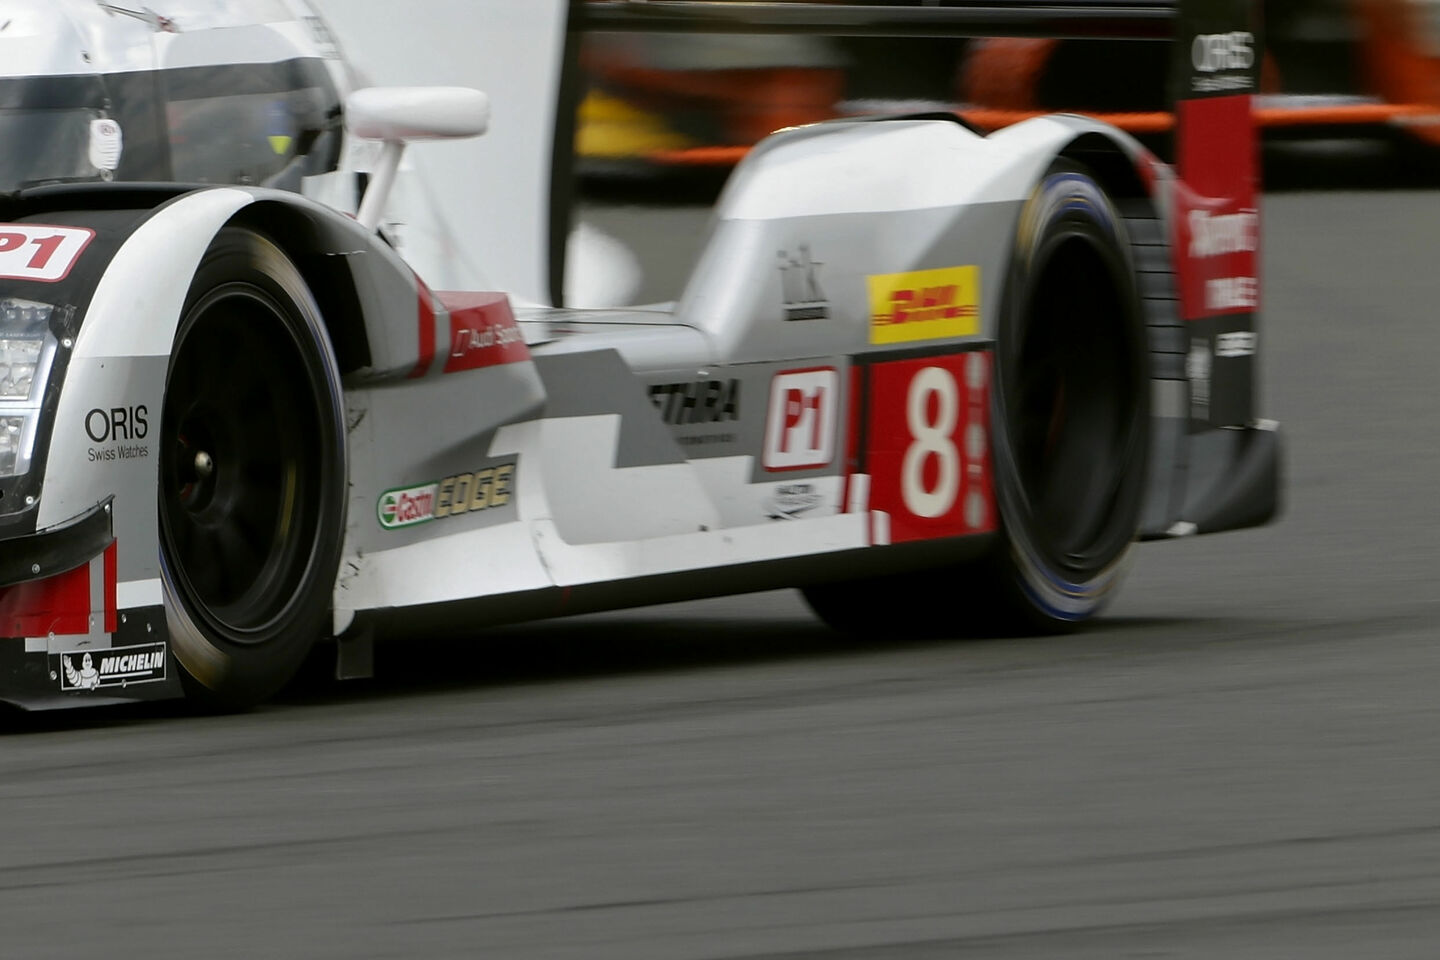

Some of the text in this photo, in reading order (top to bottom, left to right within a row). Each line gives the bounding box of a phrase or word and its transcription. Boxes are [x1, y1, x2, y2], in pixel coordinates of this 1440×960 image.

[85, 404, 148, 443] ORIS
[779, 386, 828, 453] P1
[900, 366, 961, 518] 8
[88, 444, 149, 462] Swiss Watches
[433, 463, 516, 519] EDGE
[100, 650, 164, 675] MICHELIN
